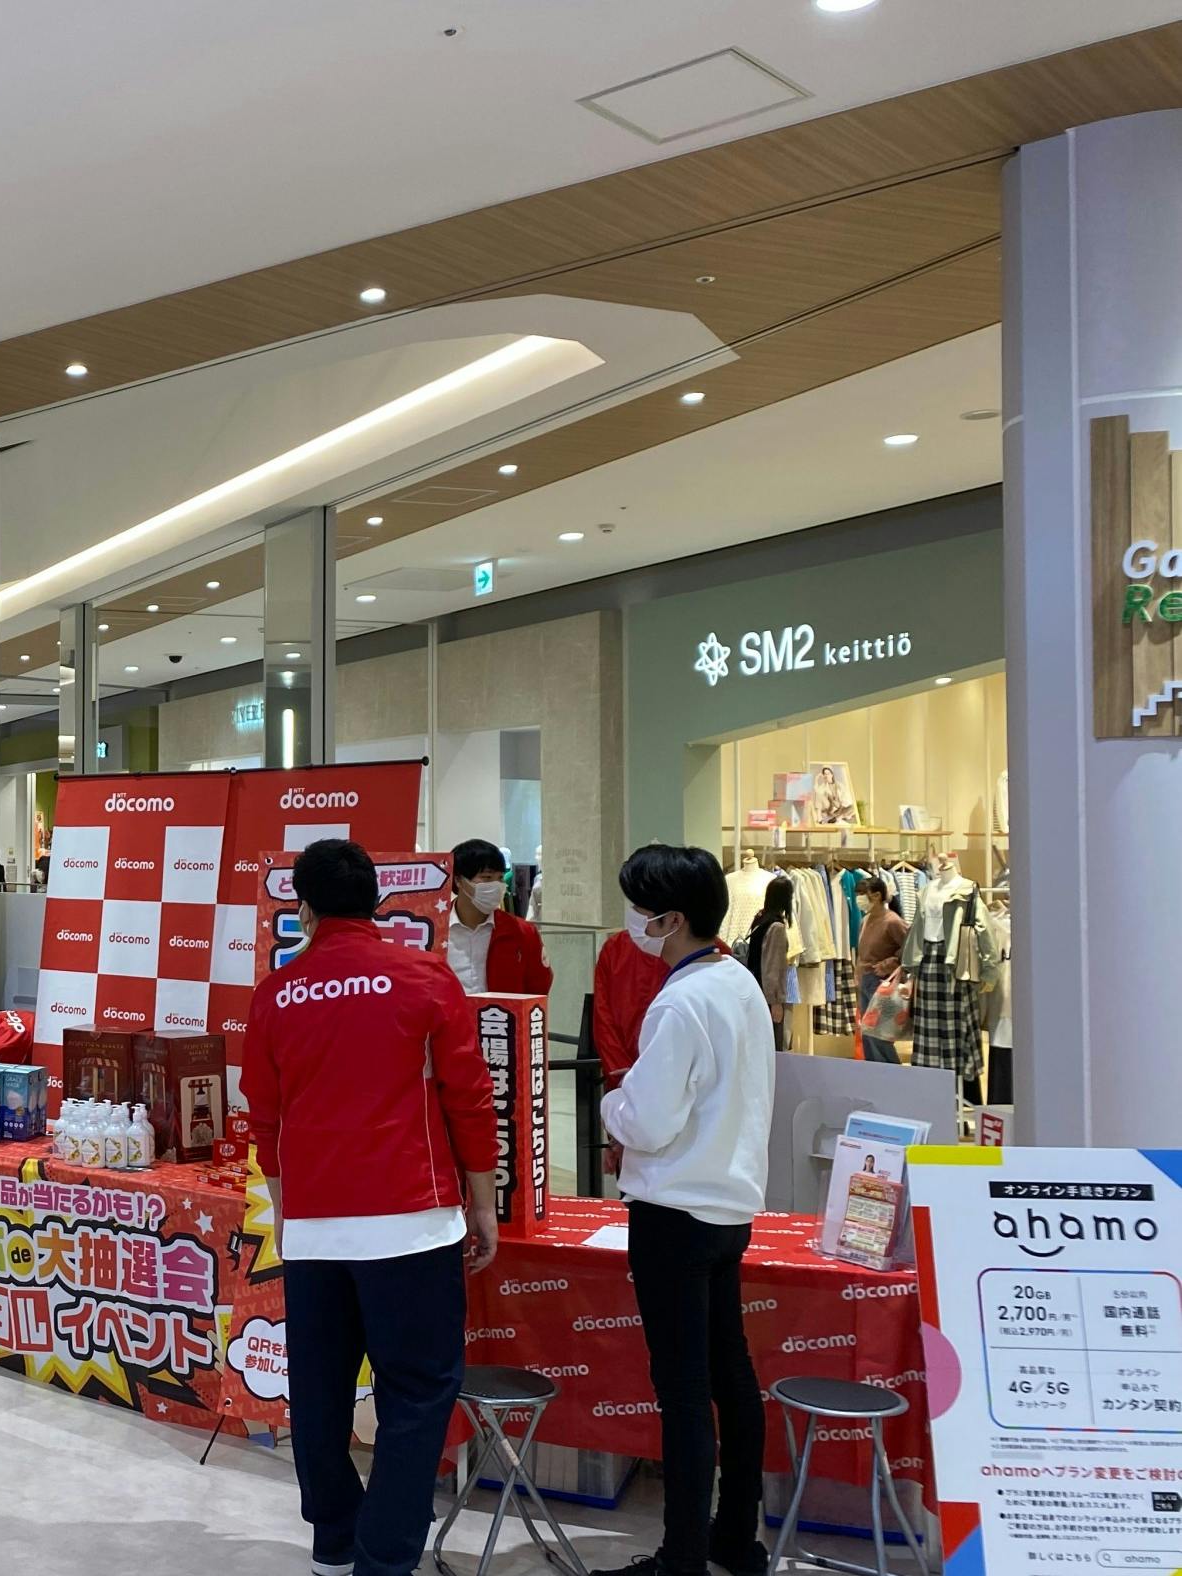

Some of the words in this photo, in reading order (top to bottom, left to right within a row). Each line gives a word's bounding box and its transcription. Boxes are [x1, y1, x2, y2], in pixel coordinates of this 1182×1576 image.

[739, 623, 815, 676] SM2
[824, 632, 912, 667] keittiö
[104, 793, 175, 813] docomo
[279, 788, 359, 809] docomo
[63, 857, 99, 869] docomo
[114, 857, 155, 870] docomo
[173, 858, 215, 871] docomo
[234, 860, 259, 872] doco
[376, 867, 427, 888] 歓迎!!
[56, 929, 93, 942] docomo
[108, 931, 151, 945] docomo
[168, 935, 210, 949] docomo
[228, 938, 254, 951] doco
[292, 976, 308, 986] NTT
[275, 975, 393, 1009] docomo
[50, 1002, 87, 1016] docomo
[103, 1006, 146, 1022] docomo
[165, 1012, 205, 1027] docomo
[1003, 1184, 1143, 1198] オンライン手続きプラン
[993, 1208, 1159, 1242] ahamo
[499, 1278, 568, 1296] docomo
[1013, 1285, 1052, 1300] 20GB
[1103, 1305, 1161, 1320] 国内通話
[573, 1314, 643, 1332] docomo
[781, 1333, 857, 1353] docomo
[1116, 1368, 1161, 1377] オンライン
[1016, 1399, 1067, 1410] ネットワーク
[1124, 1554, 1161, 1564] ahamo
